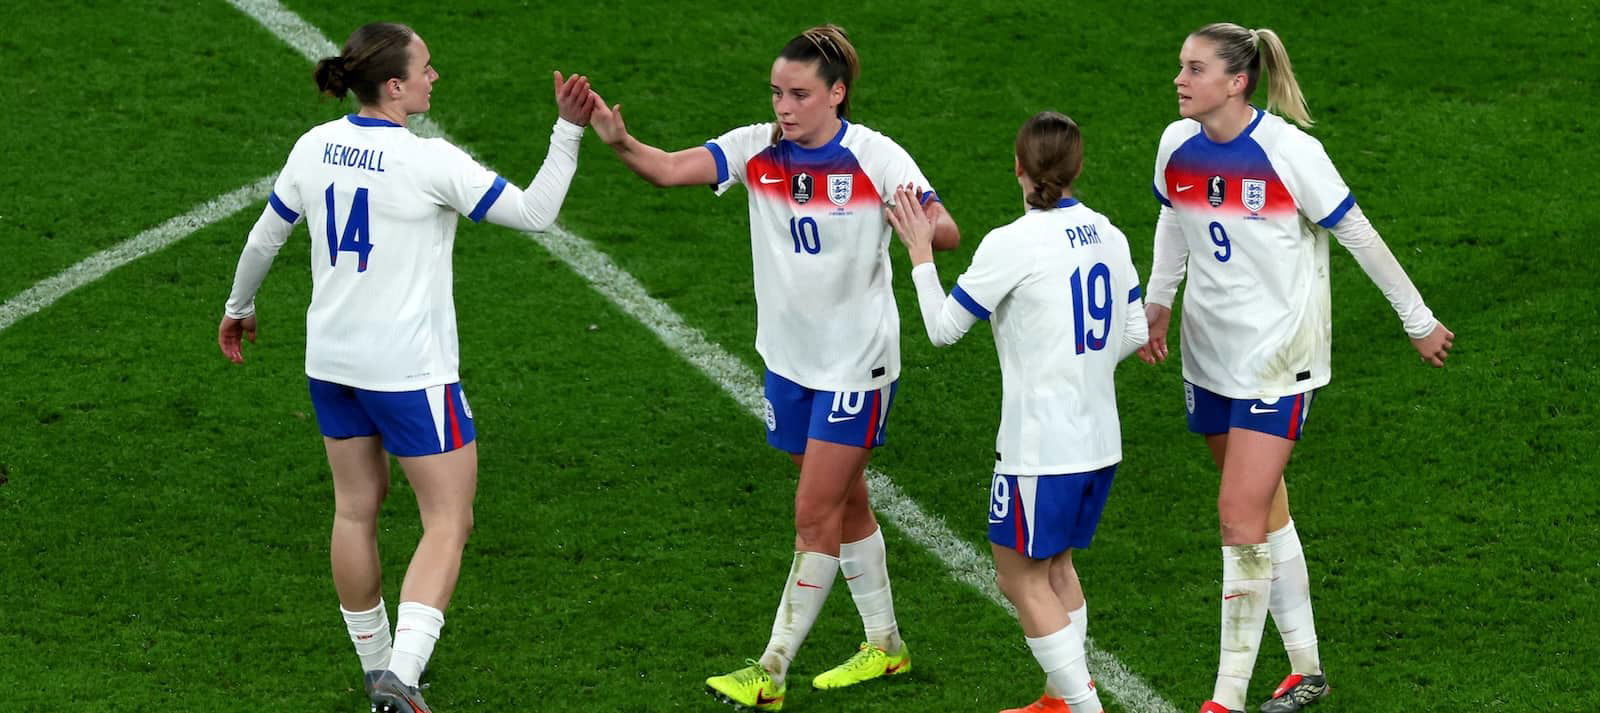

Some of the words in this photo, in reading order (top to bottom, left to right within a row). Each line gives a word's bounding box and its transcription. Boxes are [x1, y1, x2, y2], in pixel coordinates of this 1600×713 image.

[323, 142, 385, 172] KENDALL
[325, 182, 375, 273] 14
[790, 216, 821, 255] 10
[1065, 224, 1102, 249] PARK
[1208, 221, 1232, 263] 9
[1070, 262, 1113, 355] 19
